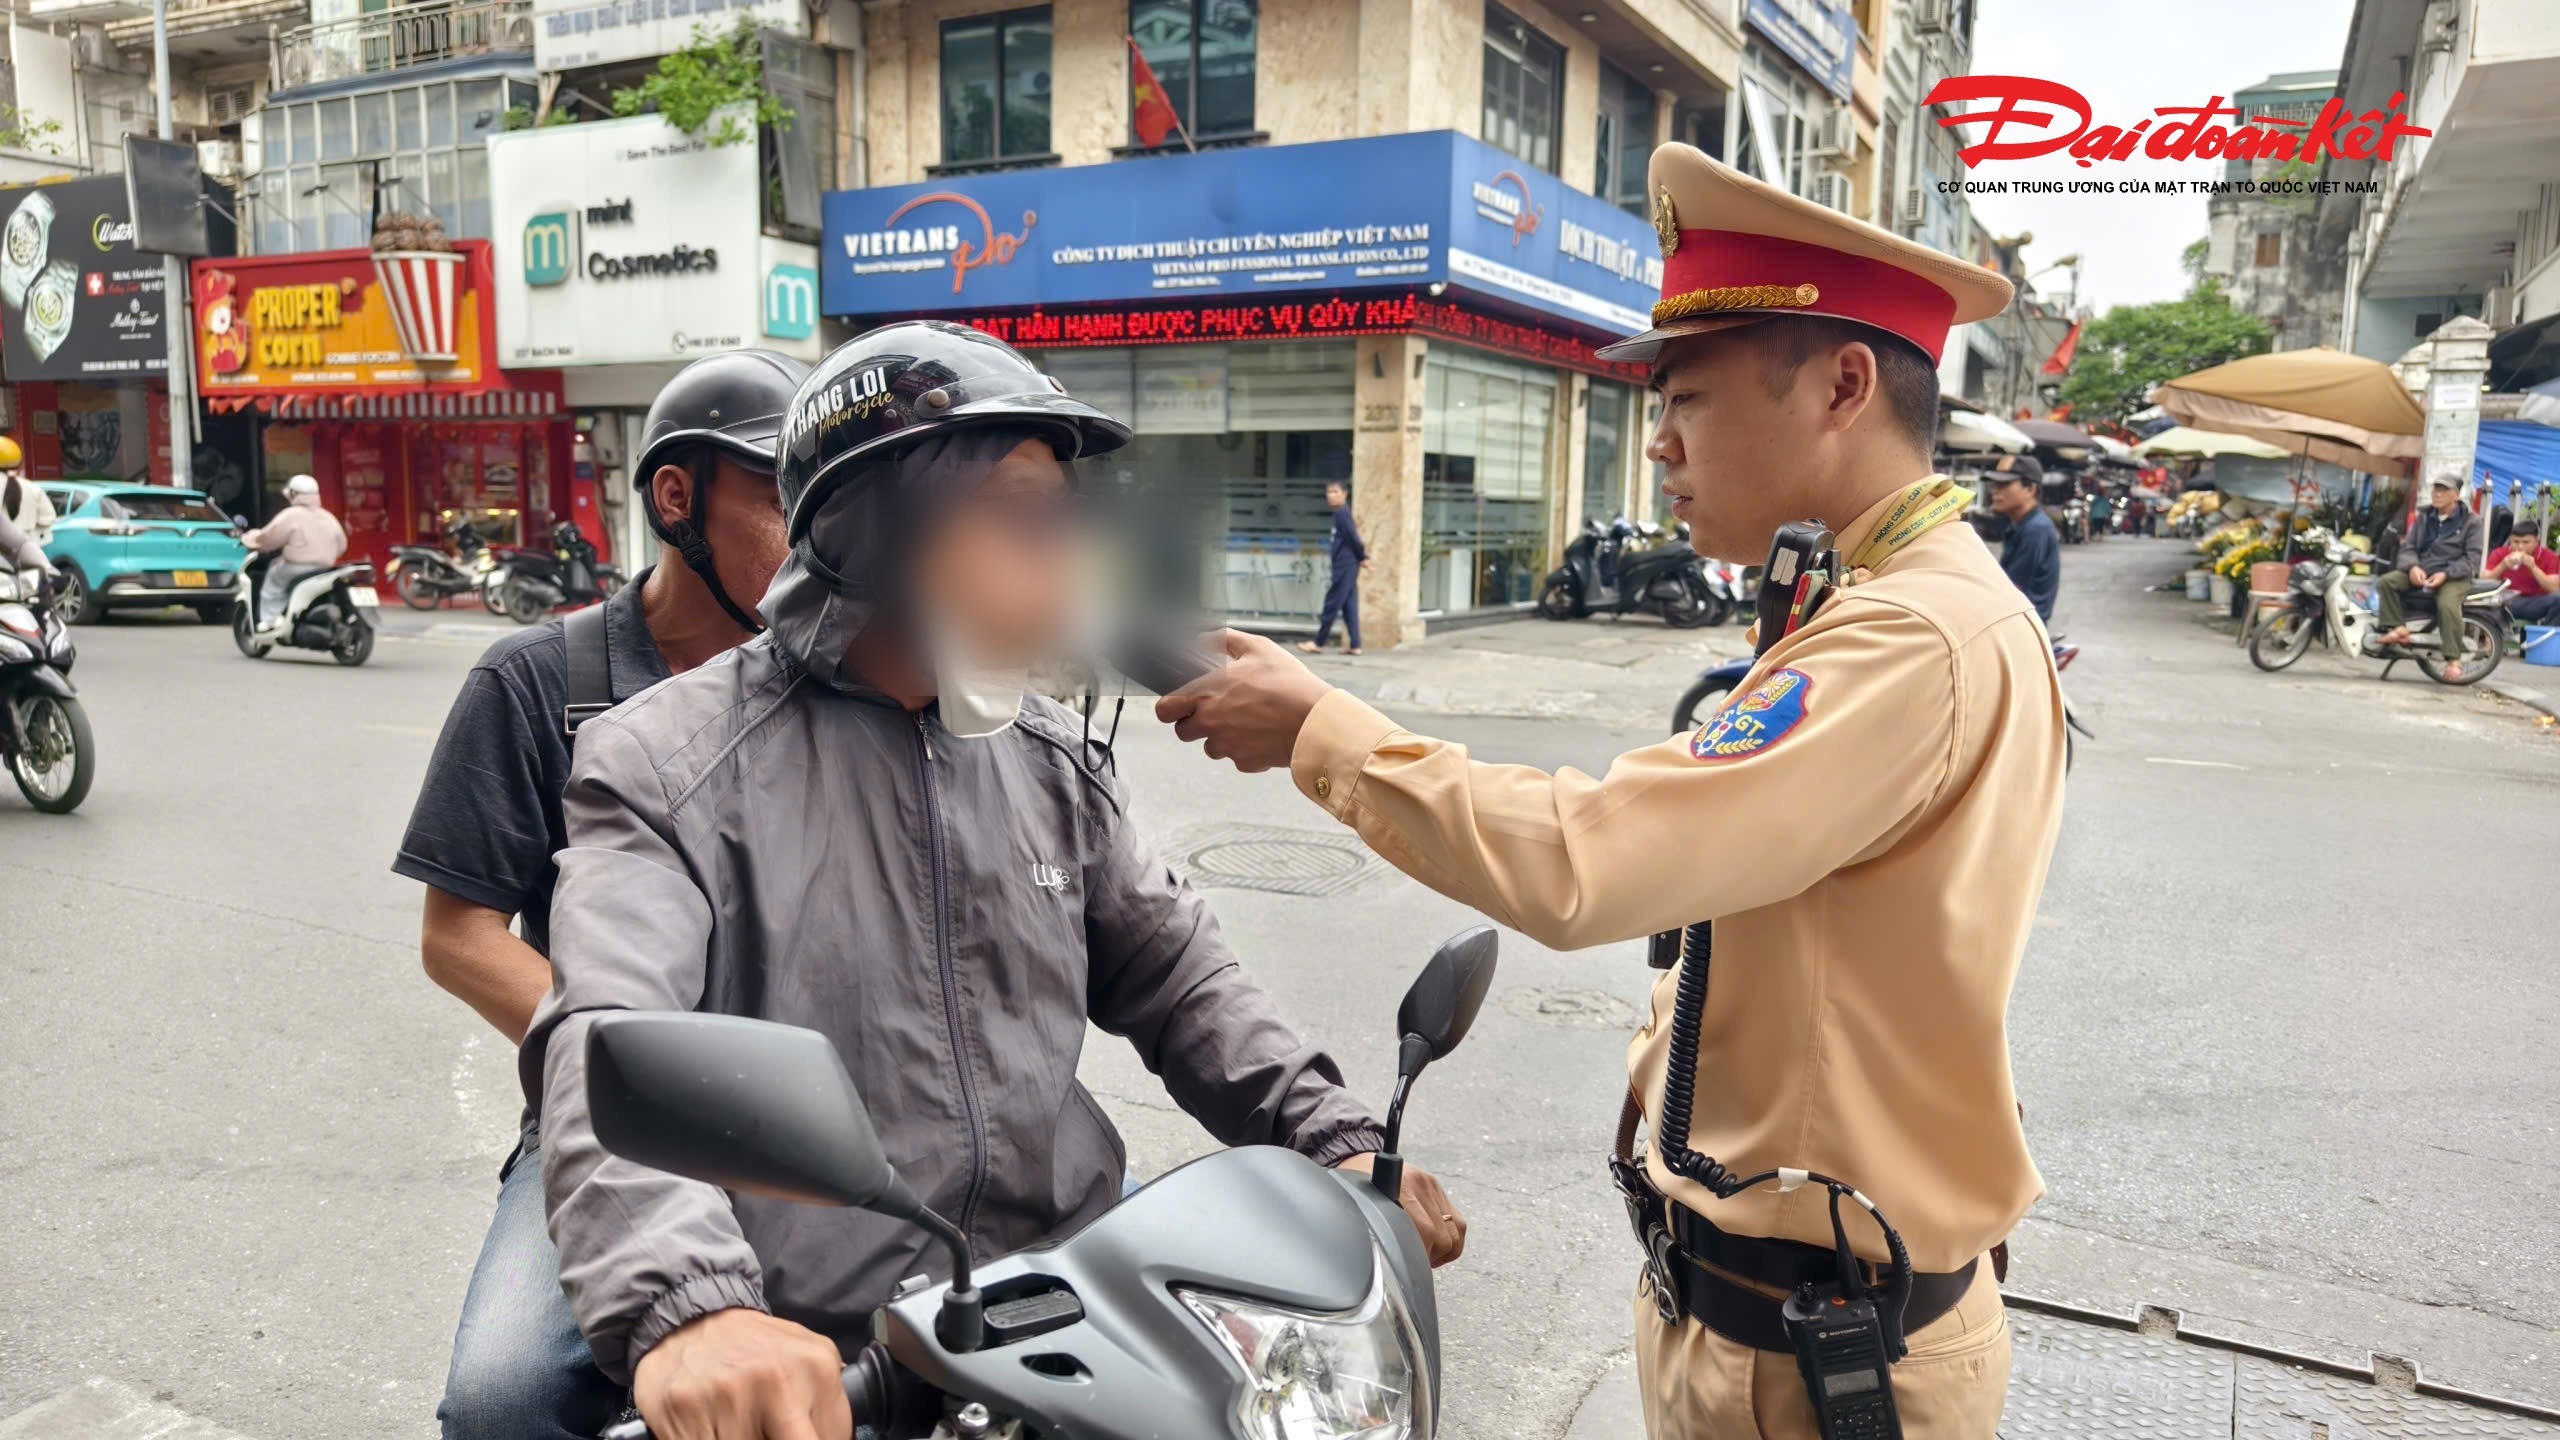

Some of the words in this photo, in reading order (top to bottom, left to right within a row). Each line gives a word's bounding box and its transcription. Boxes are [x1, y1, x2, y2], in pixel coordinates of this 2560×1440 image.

[587, 199, 633, 224] mint
[843, 225, 960, 258] VIETRANS
[1052, 245, 1094, 265] CÔNG
[1097, 246, 1115, 262] TY
[1116, 243, 1155, 262] DỊCH
[1156, 236, 1206, 259] THUẬT
[1278, 226, 1343, 250] NGHIỆP
[1344, 223, 1387, 246] VIỆT
[1389, 223, 1429, 242] NAM
[588, 246, 719, 280] Cosmetics
[1152, 259, 1205, 276] VIETNAM
[254, 283, 341, 329] PROPER
[1064, 313, 1123, 346] HẠNH
[1126, 310, 1196, 342] ĐƯỢC
[1201, 306, 1264, 337] PHỤC
[1268, 304, 1303, 334] VỤ
[258, 331, 325, 366] corn
[849, 366, 888, 403] LOI
[819, 391, 895, 439] Motorcycle
